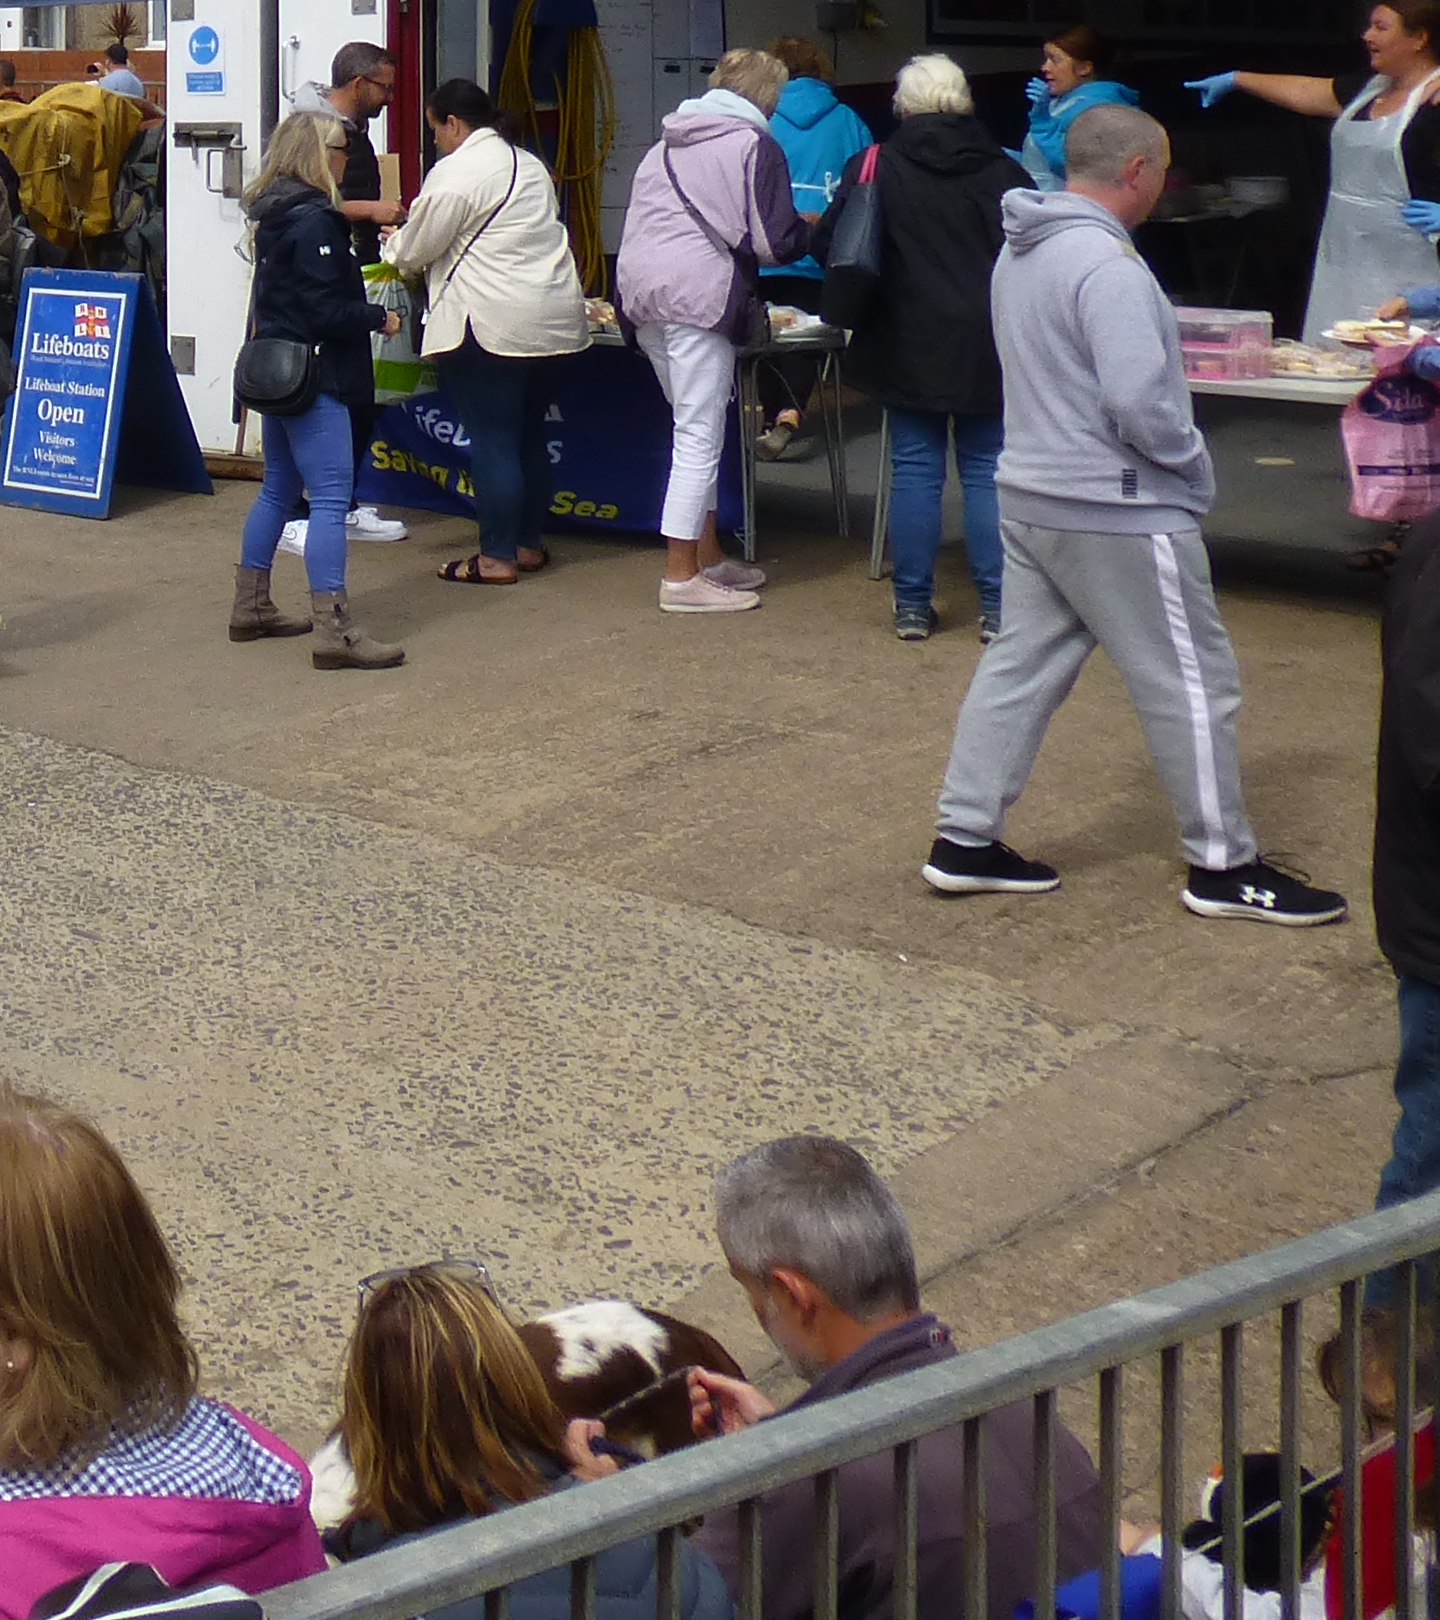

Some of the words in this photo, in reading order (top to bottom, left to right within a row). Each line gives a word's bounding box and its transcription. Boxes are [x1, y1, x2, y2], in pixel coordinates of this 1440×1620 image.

[31, 332, 110, 360] Lifeboats
[25, 376, 65, 394] Lifeboat
[66, 381, 105, 398] Station
[37, 398, 85, 427] Open
[39, 430, 75, 447] Visitors
[33, 447, 77, 465] Welcome
[548, 490, 619, 519] Sea
